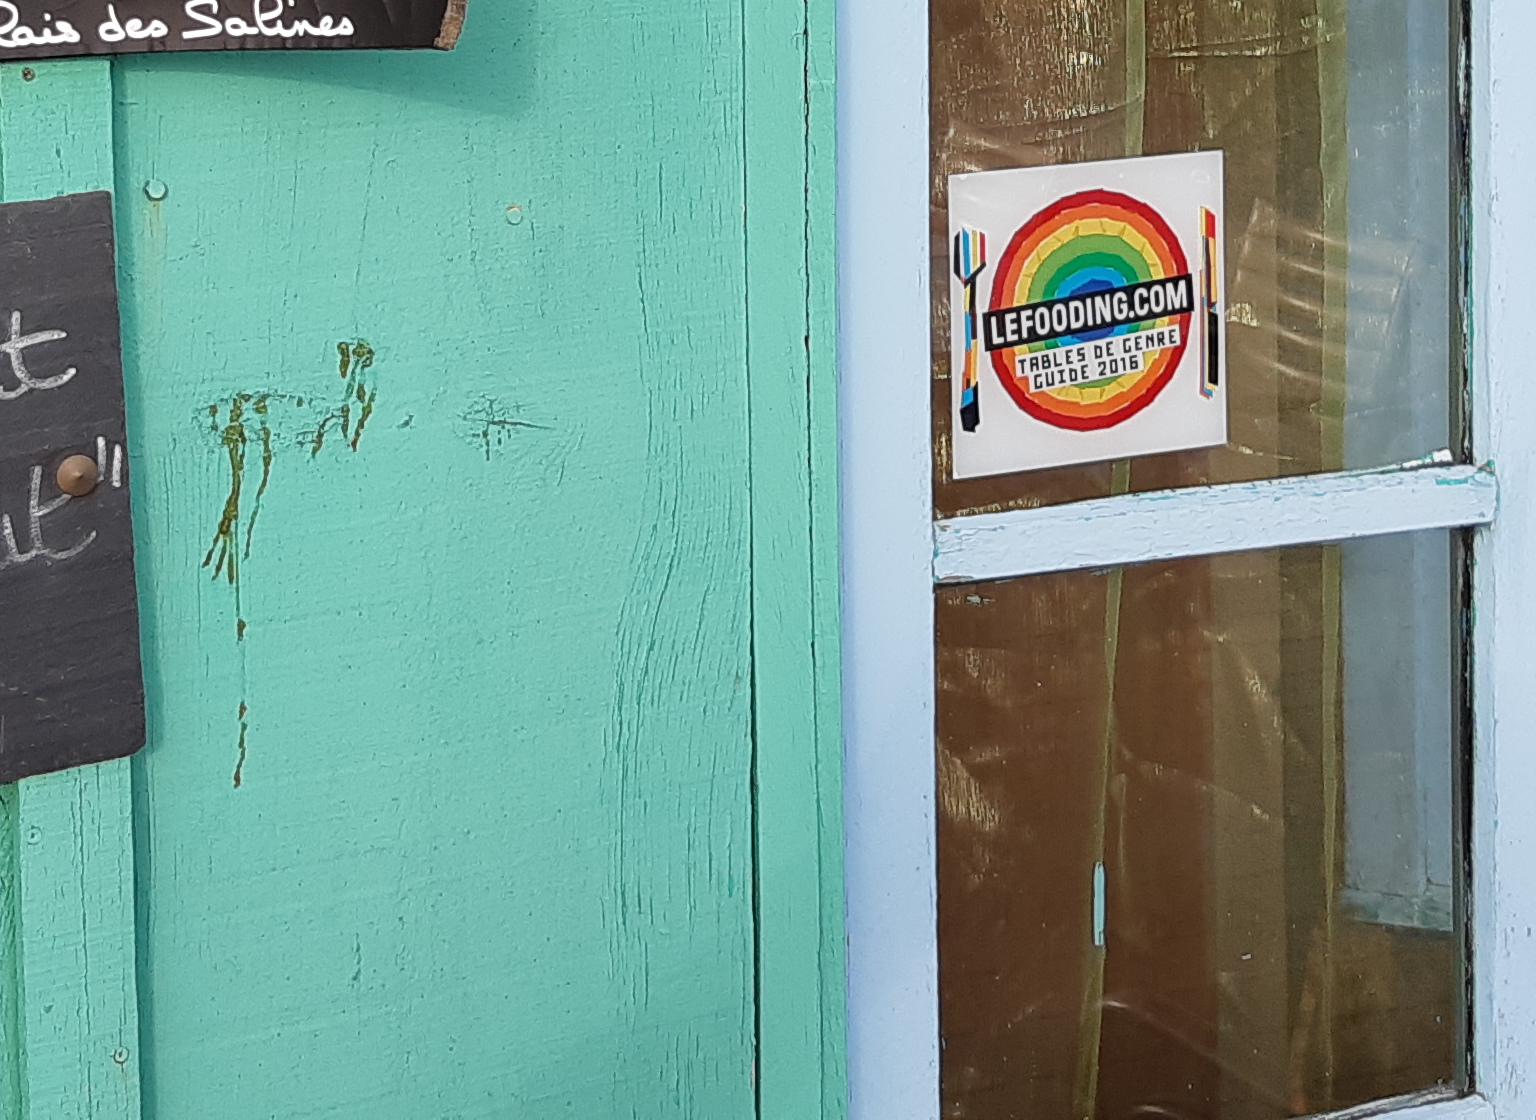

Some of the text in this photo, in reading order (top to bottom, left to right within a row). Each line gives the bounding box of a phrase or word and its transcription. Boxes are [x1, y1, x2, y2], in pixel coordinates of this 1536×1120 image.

[98, 4, 168, 42] des
[990, 280, 1188, 345] LEFOODING.COM
[1018, 328, 1178, 375] TABLES DE GENRE
[1034, 354, 1139, 390] GUIDE 2016
